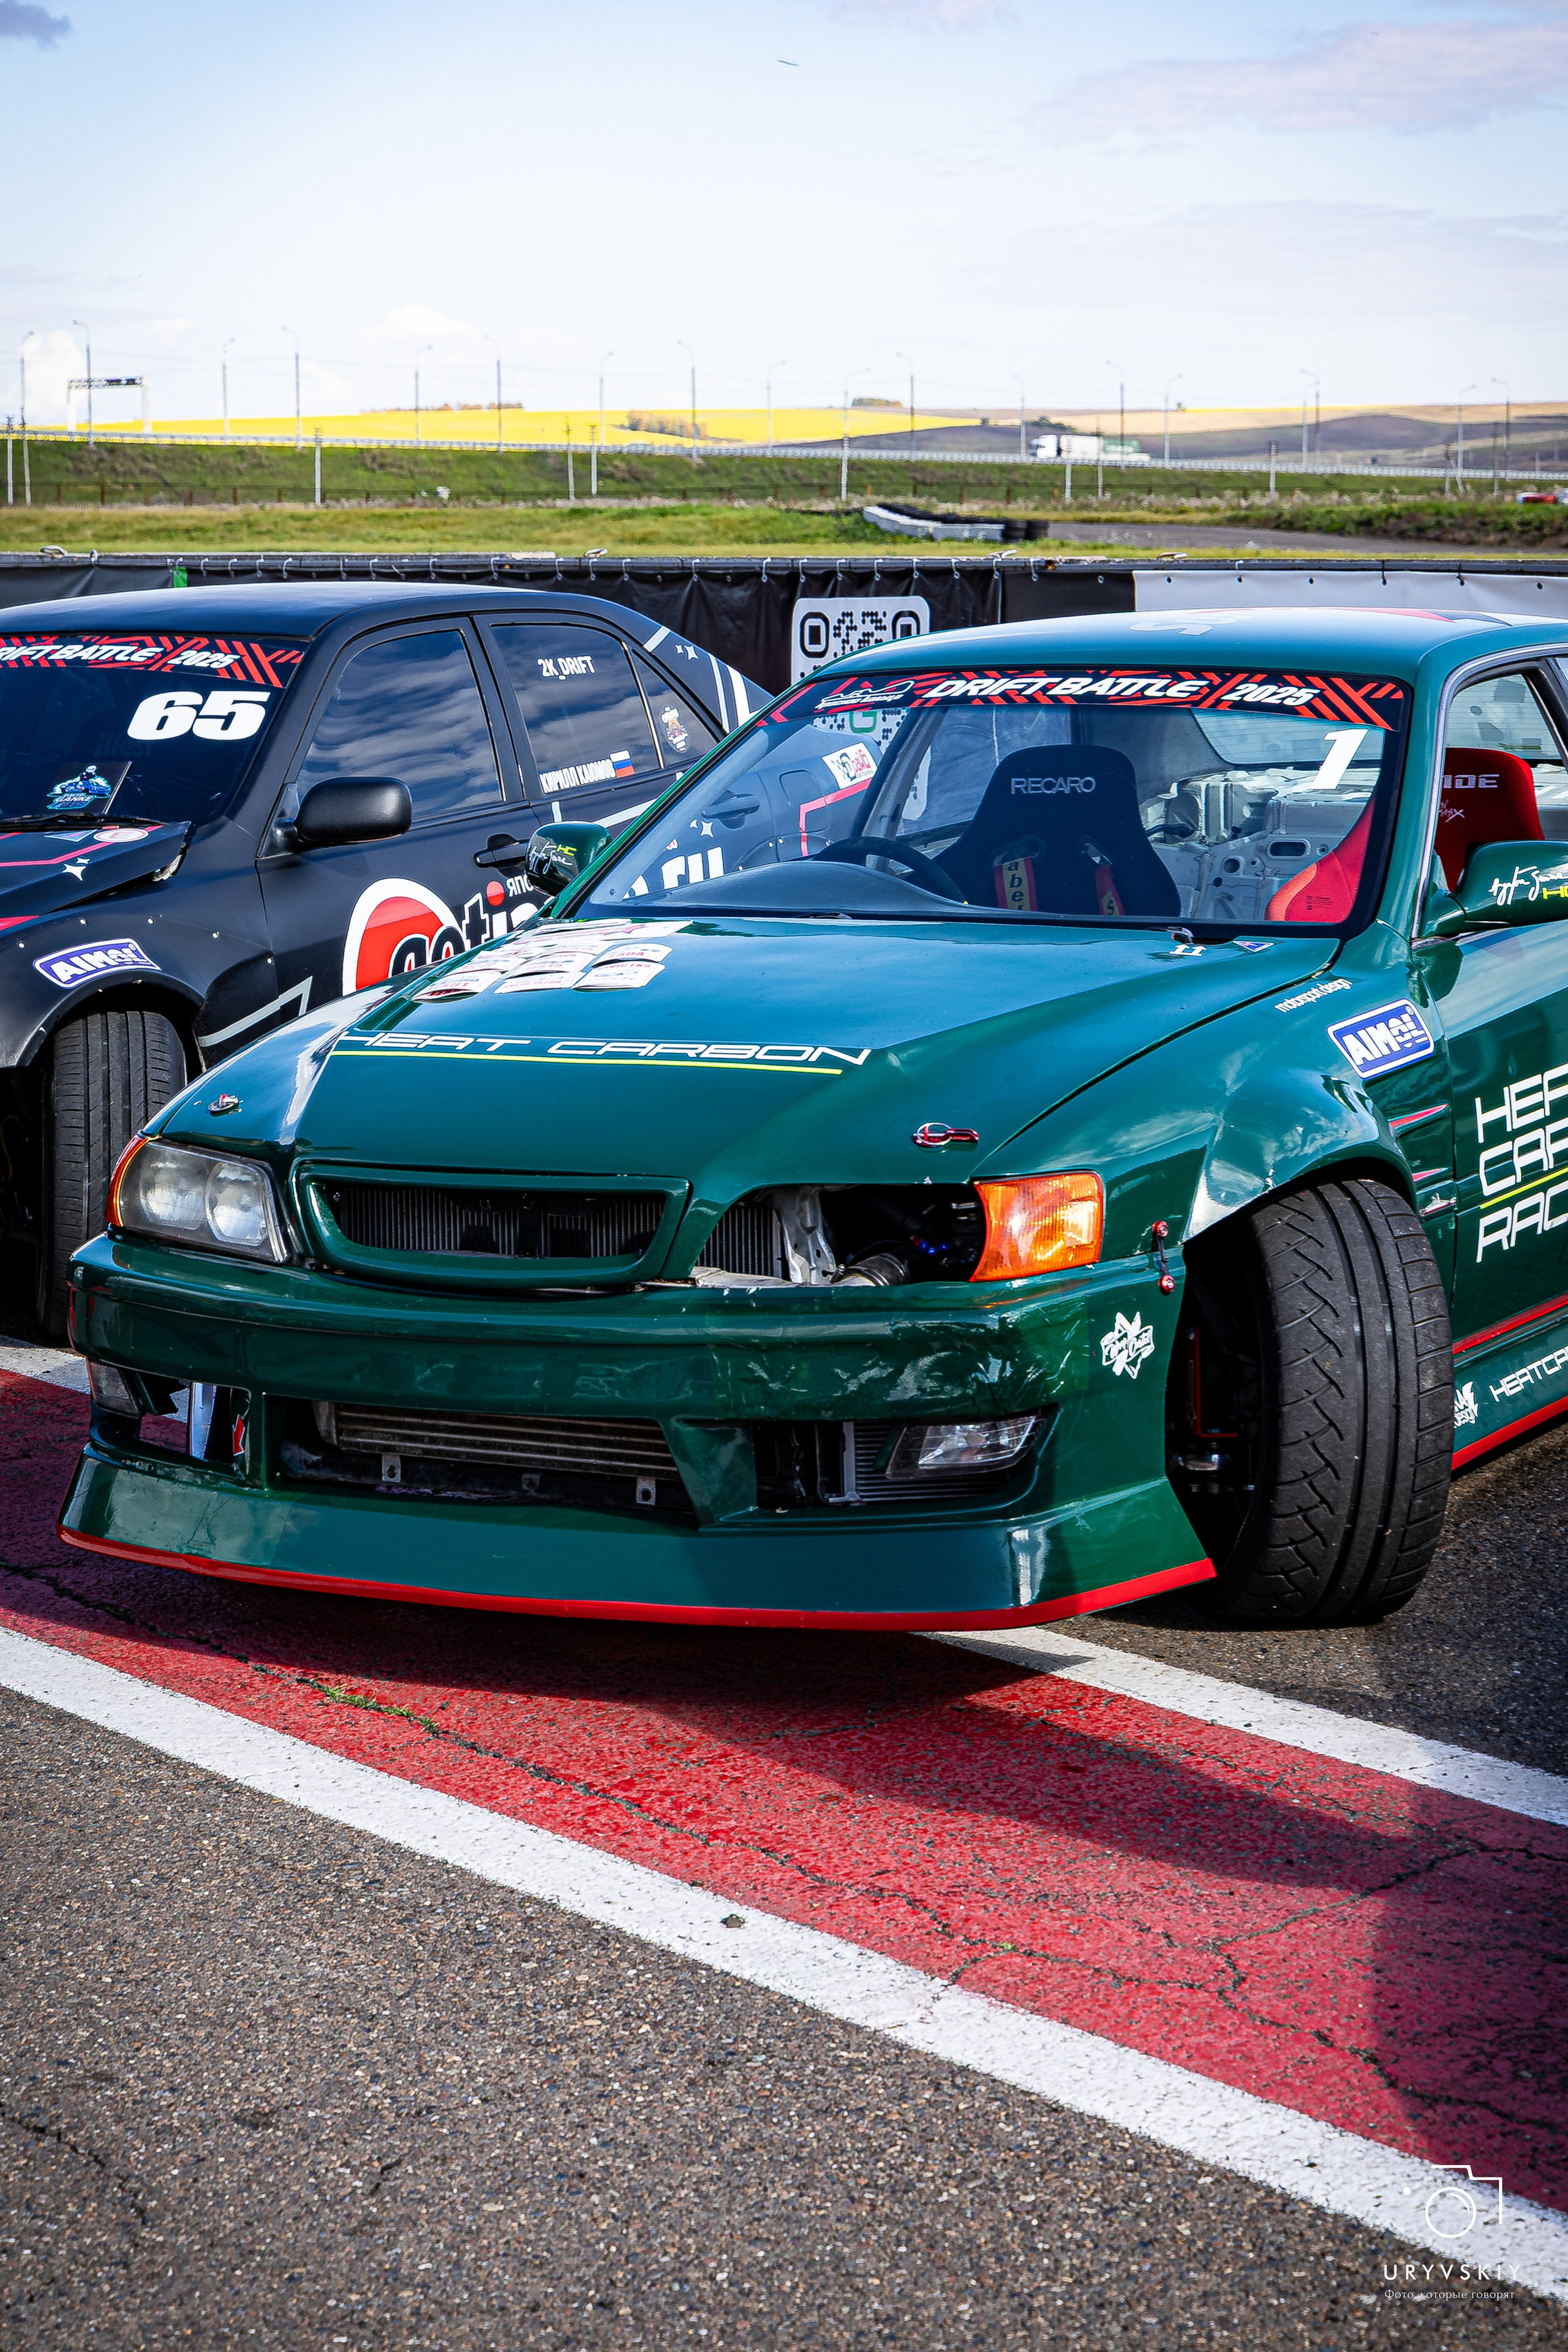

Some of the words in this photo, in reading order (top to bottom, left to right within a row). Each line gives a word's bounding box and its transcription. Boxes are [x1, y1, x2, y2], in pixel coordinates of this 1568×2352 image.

[48, 644, 164, 662] BATTLE
[167, 650, 241, 668] 2025
[921, 677, 1062, 699] DRIFT
[1044, 677, 1210, 699] BATTLE
[1221, 682, 1321, 706] 2025
[127, 690, 271, 741] 65
[1311, 728, 1370, 790] 1
[1011, 777, 1096, 794] RECARO
[1274, 987, 1329, 1013] motorsport
[1316, 978, 1354, 995] design
[338, 1031, 530, 1052] HEAT
[547, 1040, 872, 1066] CARBON
